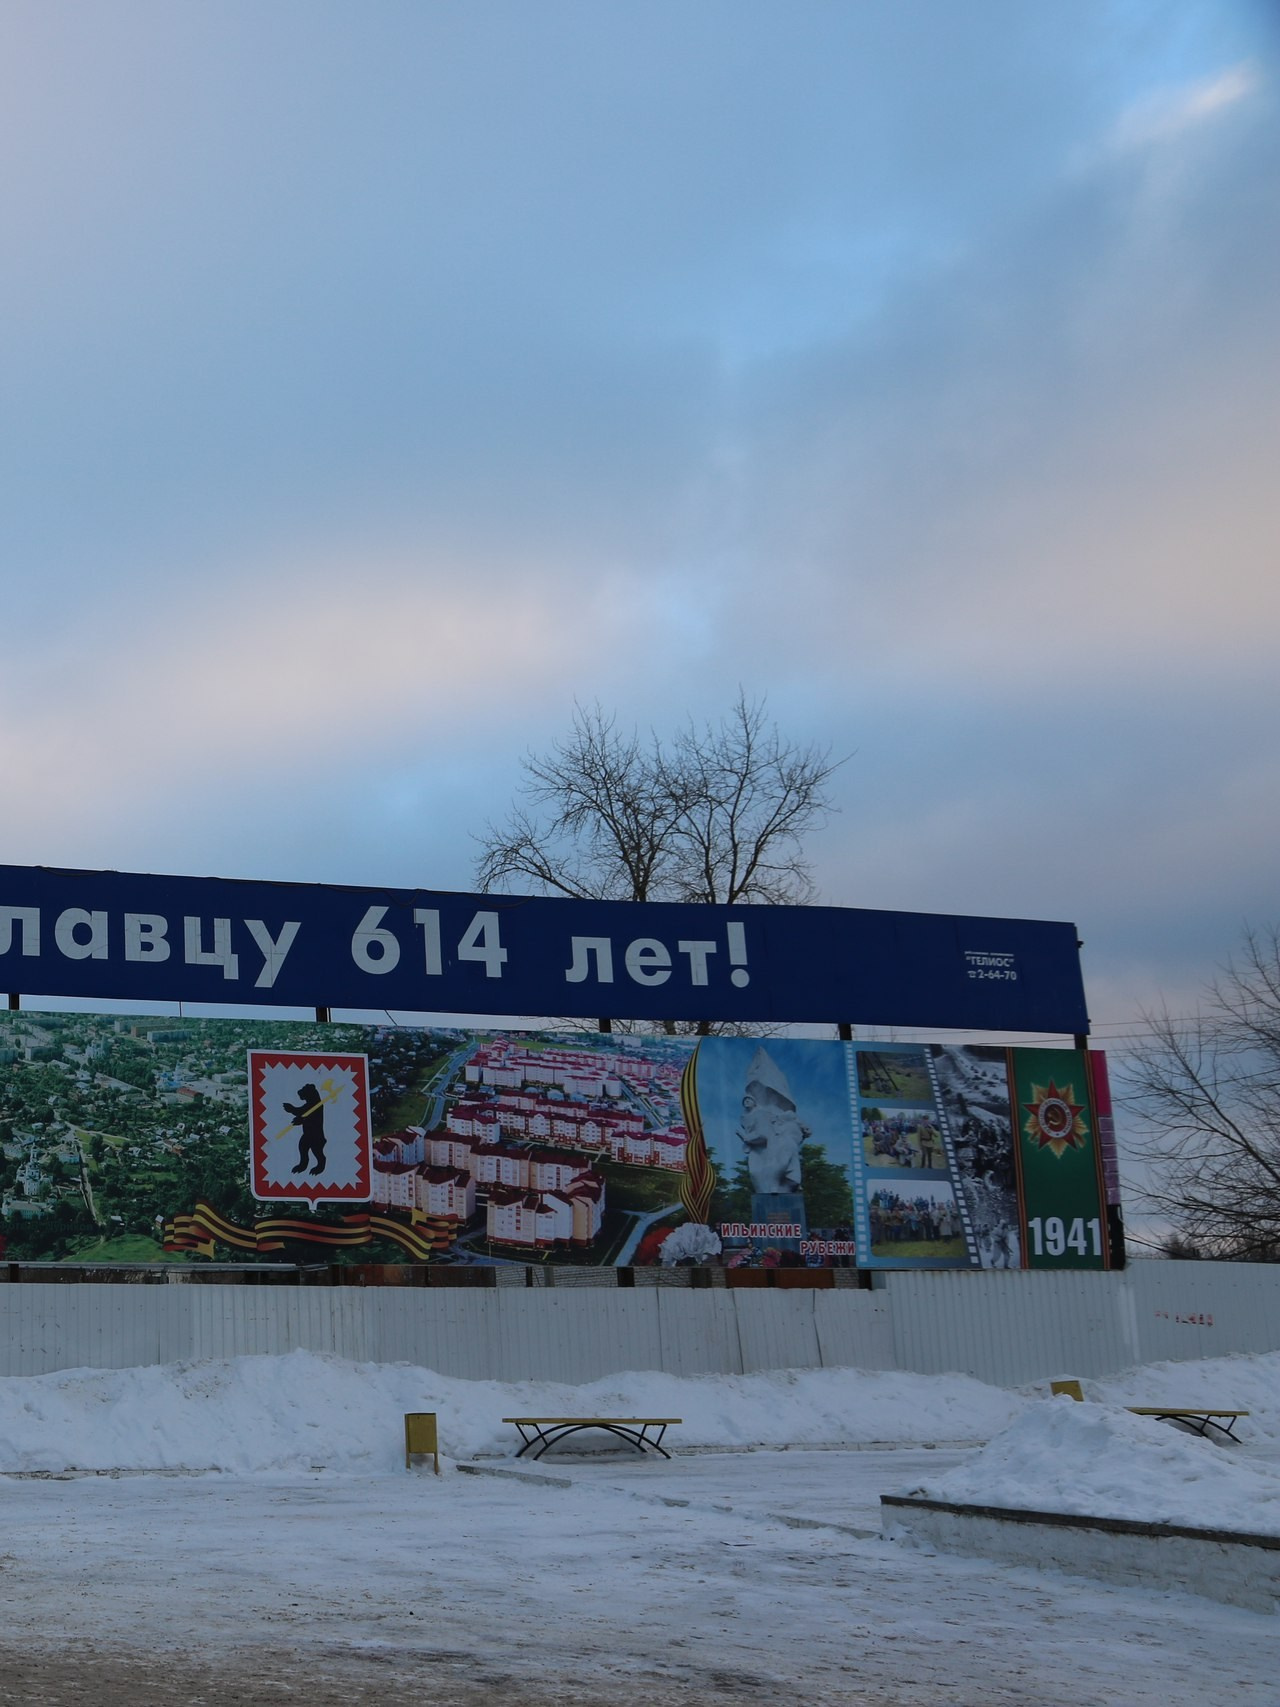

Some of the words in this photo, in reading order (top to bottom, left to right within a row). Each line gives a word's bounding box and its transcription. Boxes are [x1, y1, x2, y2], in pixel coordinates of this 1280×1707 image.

[351, 905, 508, 978] 614
[565, 921, 751, 989] лет!
[977, 969, 1017, 981] 2-64-70
[721, 1221, 802, 1238] ИЛЬИНСКИЕ
[1028, 1216, 1102, 1257] 1941
[799, 1240, 856, 1256] РУБЕЖИ
